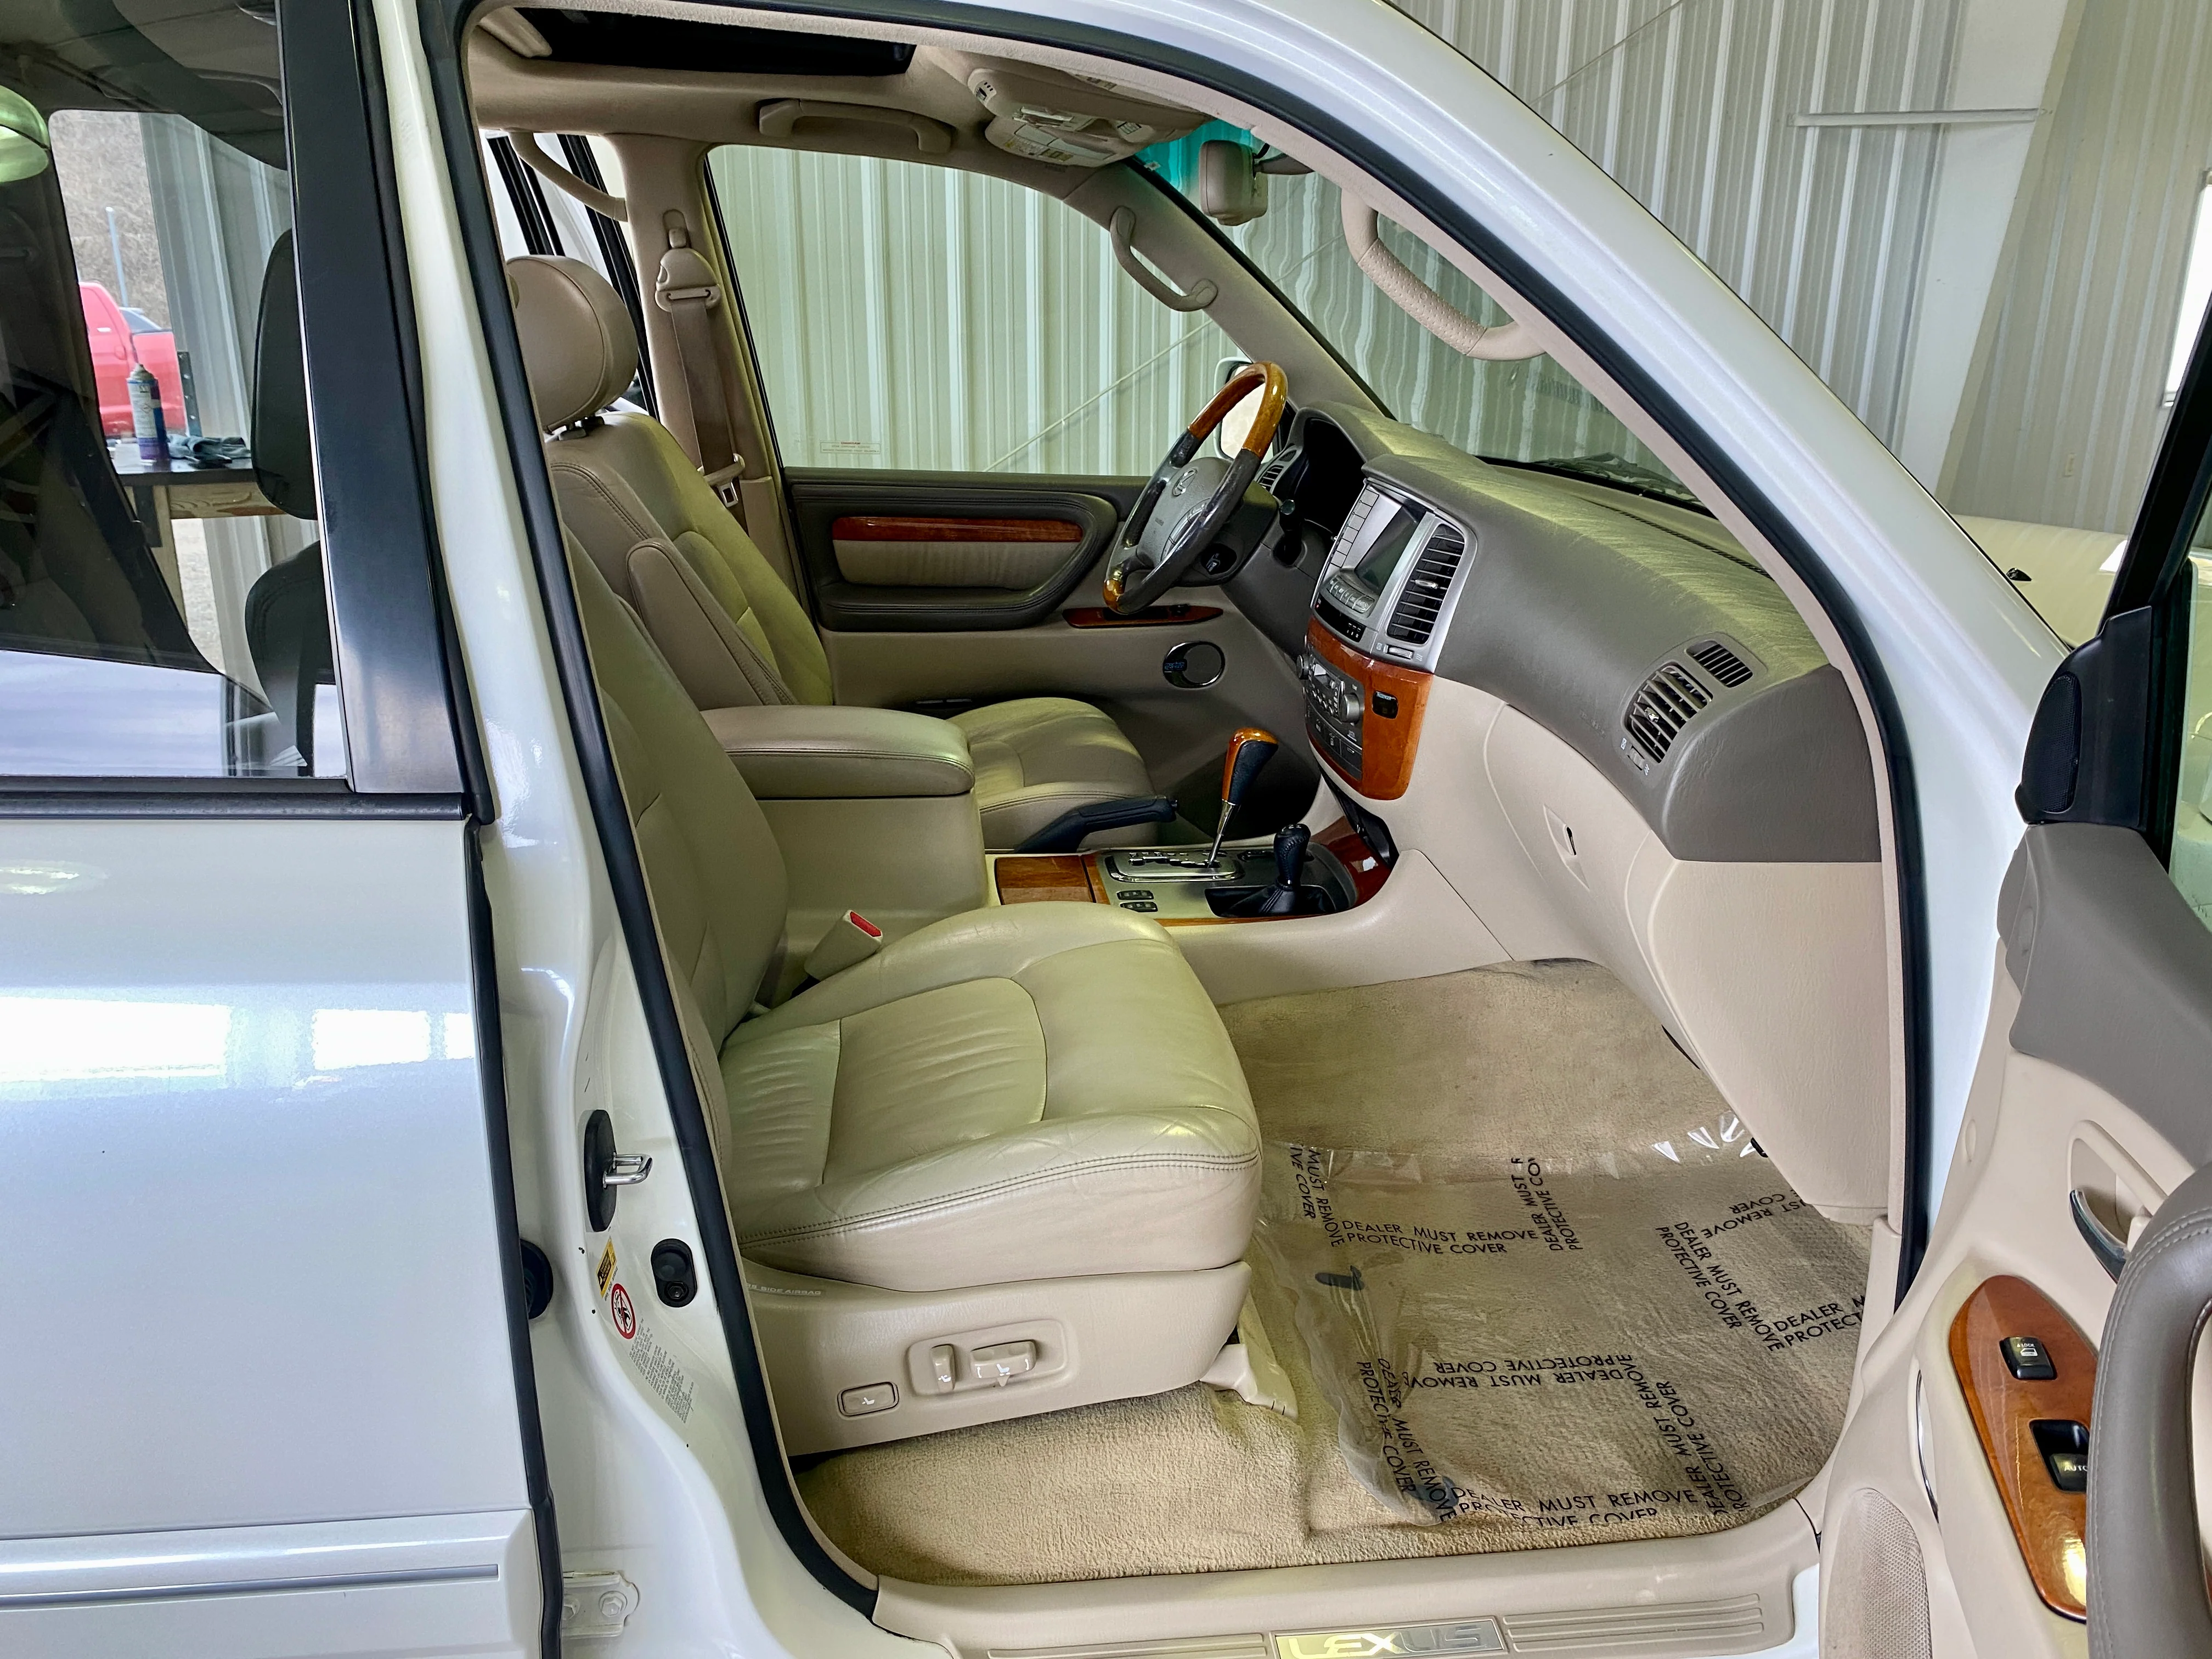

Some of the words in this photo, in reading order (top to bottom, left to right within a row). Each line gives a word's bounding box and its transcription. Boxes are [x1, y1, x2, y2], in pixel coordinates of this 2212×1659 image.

[1296, 1173, 1317, 1219] COVER
[1307, 1149, 1325, 1192] MUST
[1316, 1197, 1345, 1248] REMOVE
[1511, 1175, 1538, 1207] MUST
[1729, 1194, 1785, 1214] COVER
[1342, 1221, 1403, 1233] DEALER
[1414, 1226, 1457, 1242] MUST
[1467, 1230, 1539, 1242] REMOVE
[1531, 1212, 1564, 1251] DEALER
[1536, 1190, 1583, 1250] PROTECTIVE
[1701, 1208, 1773, 1239] REMOVE
[1347, 1233, 1443, 1254] PROTECTIVE
[1450, 1243, 1508, 1254] COVER
[1655, 1226, 1712, 1288] PROTECTIVE
[1705, 1290, 1742, 1329] COVER
[1674, 1222, 1712, 1261] DEALER
[1706, 1265, 1742, 1296] MUST
[1735, 1300, 1785, 1352] REMOVE
[1773, 1302, 1843, 1332] DEALER
[1434, 1361, 1497, 1374] COVER
[1490, 1374, 1541, 1387] MUST
[1504, 1355, 1616, 1372] PROTECTIVE
[1553, 1369, 1624, 1384] DEALER
[1616, 1354, 1662, 1408] REMOVE
[1656, 1381, 1695, 1427] COVER
[1653, 1416, 1692, 1457] MUST
[1383, 1444, 1417, 1493] COVER
[1392, 1417, 1425, 1454] MUST
[1413, 1460, 1458, 1522] REMOVE
[1687, 1433, 1751, 1513] ROTECTIVE
[1451, 1486, 1526, 1512] DEALER
[1538, 1494, 1597, 1513] MUST
[1609, 1489, 1699, 1508] REMOVE
[1288, 1626, 1486, 1659] LEXUS
